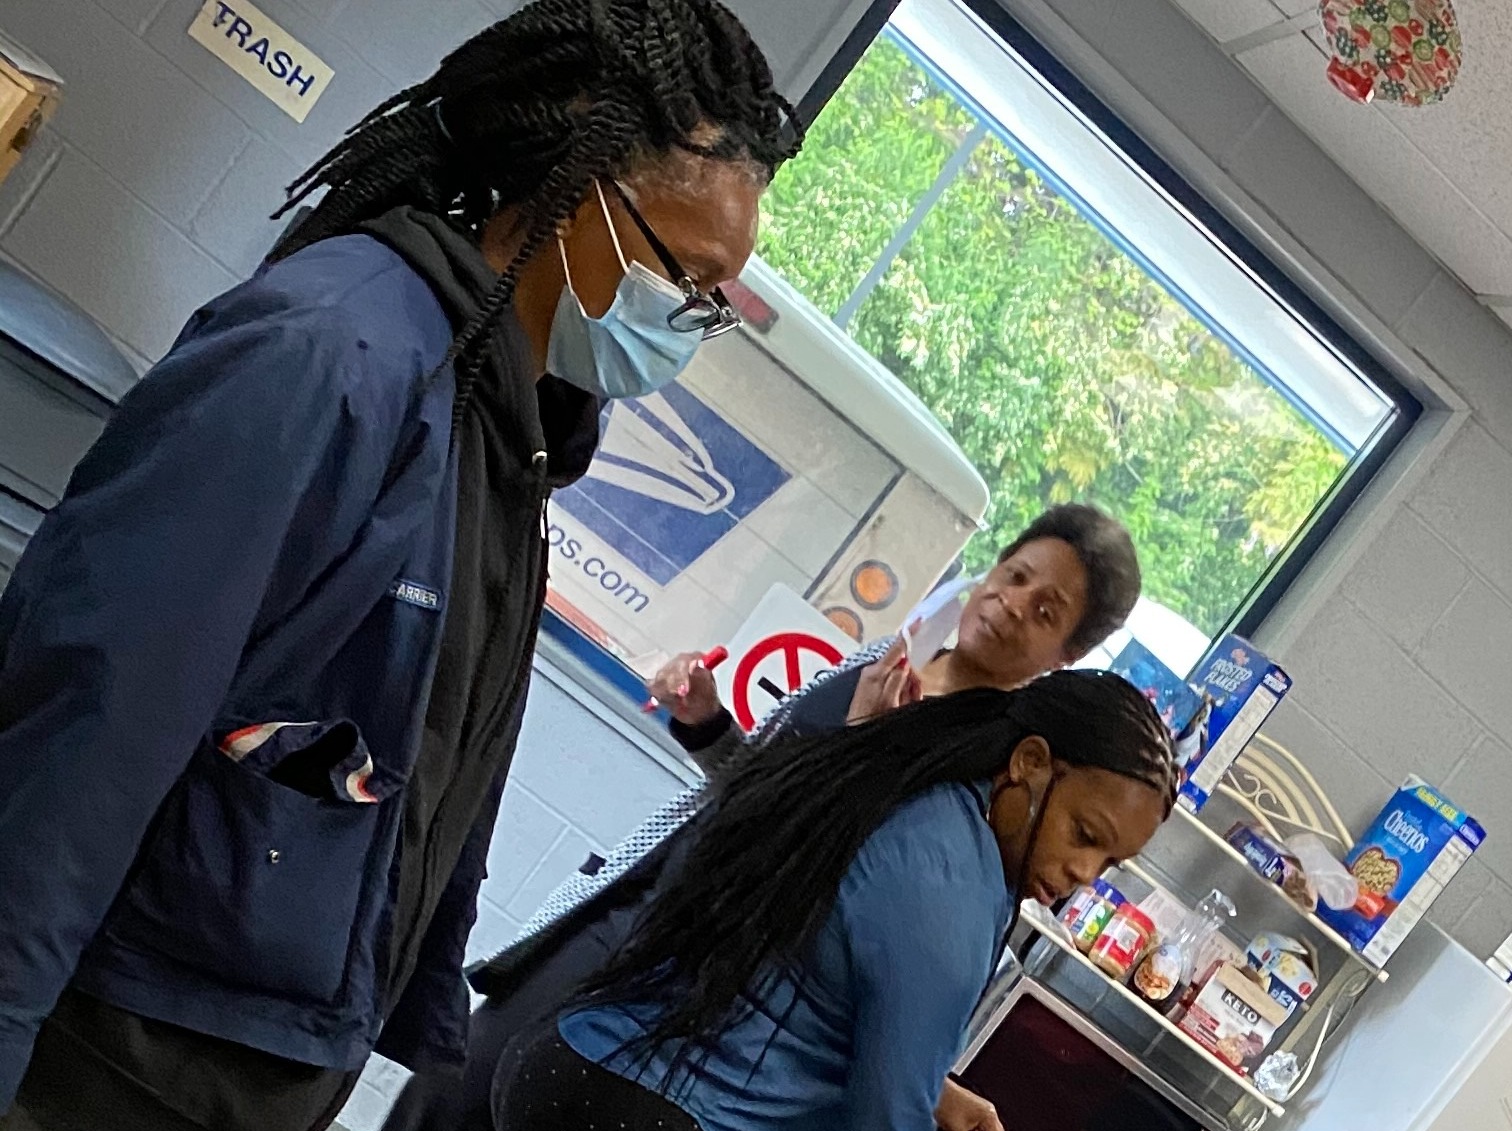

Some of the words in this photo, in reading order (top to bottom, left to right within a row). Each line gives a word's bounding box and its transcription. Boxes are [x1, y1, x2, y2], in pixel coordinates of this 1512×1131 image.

[212, 1, 315, 97] TRASH
[391, 583, 438, 606] ARRIER
[1204, 673, 1240, 693] FLAKES
[1210, 658, 1253, 683] FROSTED
[1384, 809, 1430, 854] Cheerios
[1224, 992, 1259, 1024] KETO
